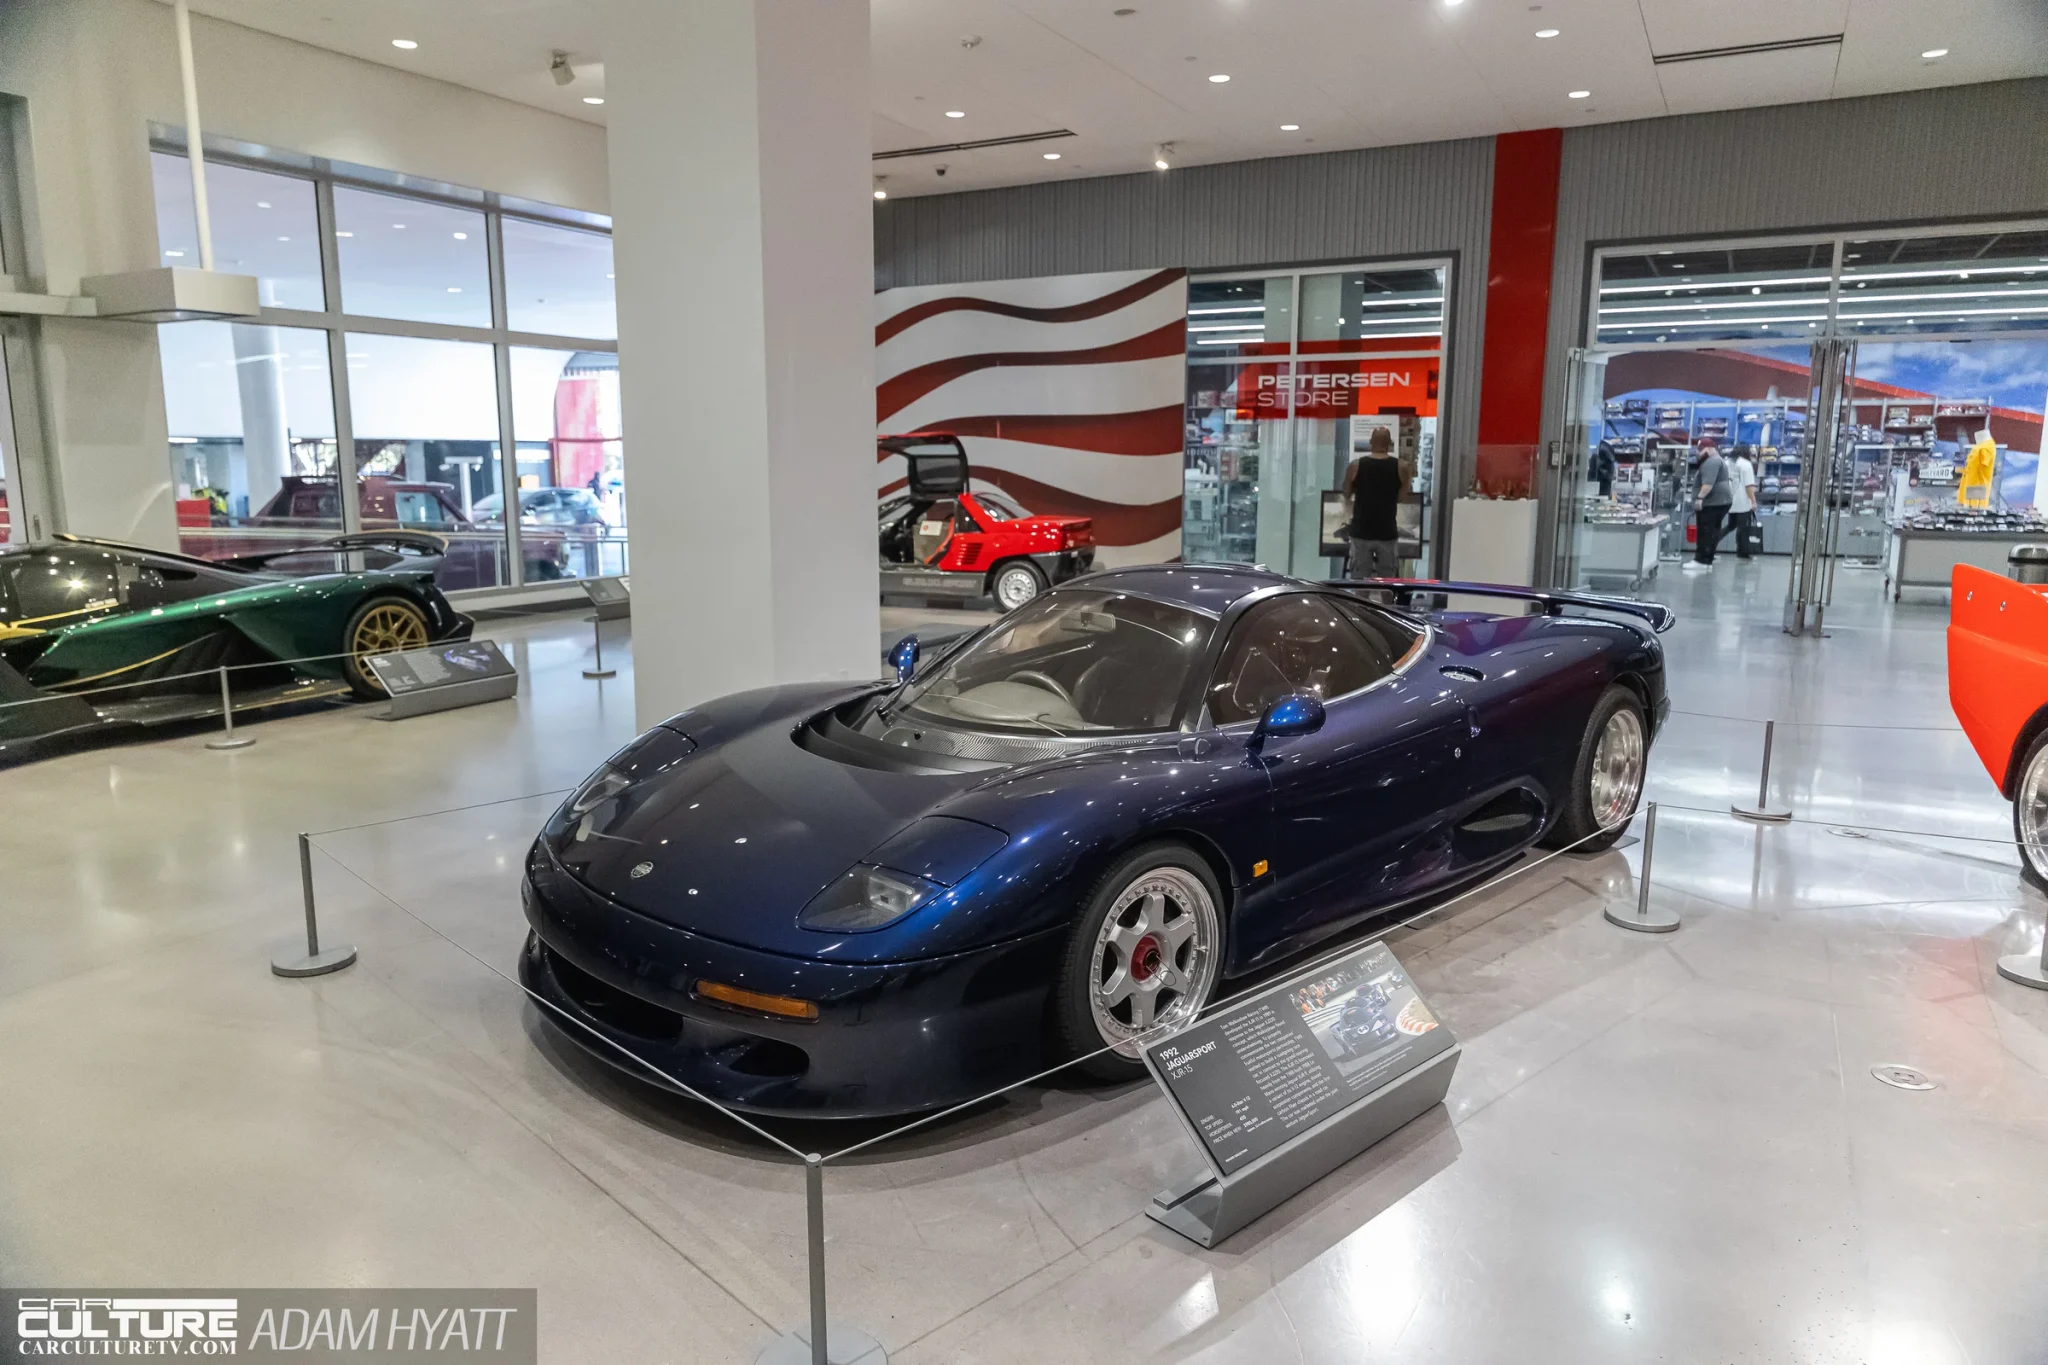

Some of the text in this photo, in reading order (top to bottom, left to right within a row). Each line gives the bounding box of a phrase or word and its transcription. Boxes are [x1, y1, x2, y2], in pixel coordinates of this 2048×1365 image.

[1258, 372, 1410, 389] PETERSEN
[1258, 391, 1349, 407] STORE
[1159, 1047, 1179, 1060] 1992
[1166, 1041, 1216, 1070] JAGUARSPORT
[1170, 1064, 1193, 1079] XJR-15
